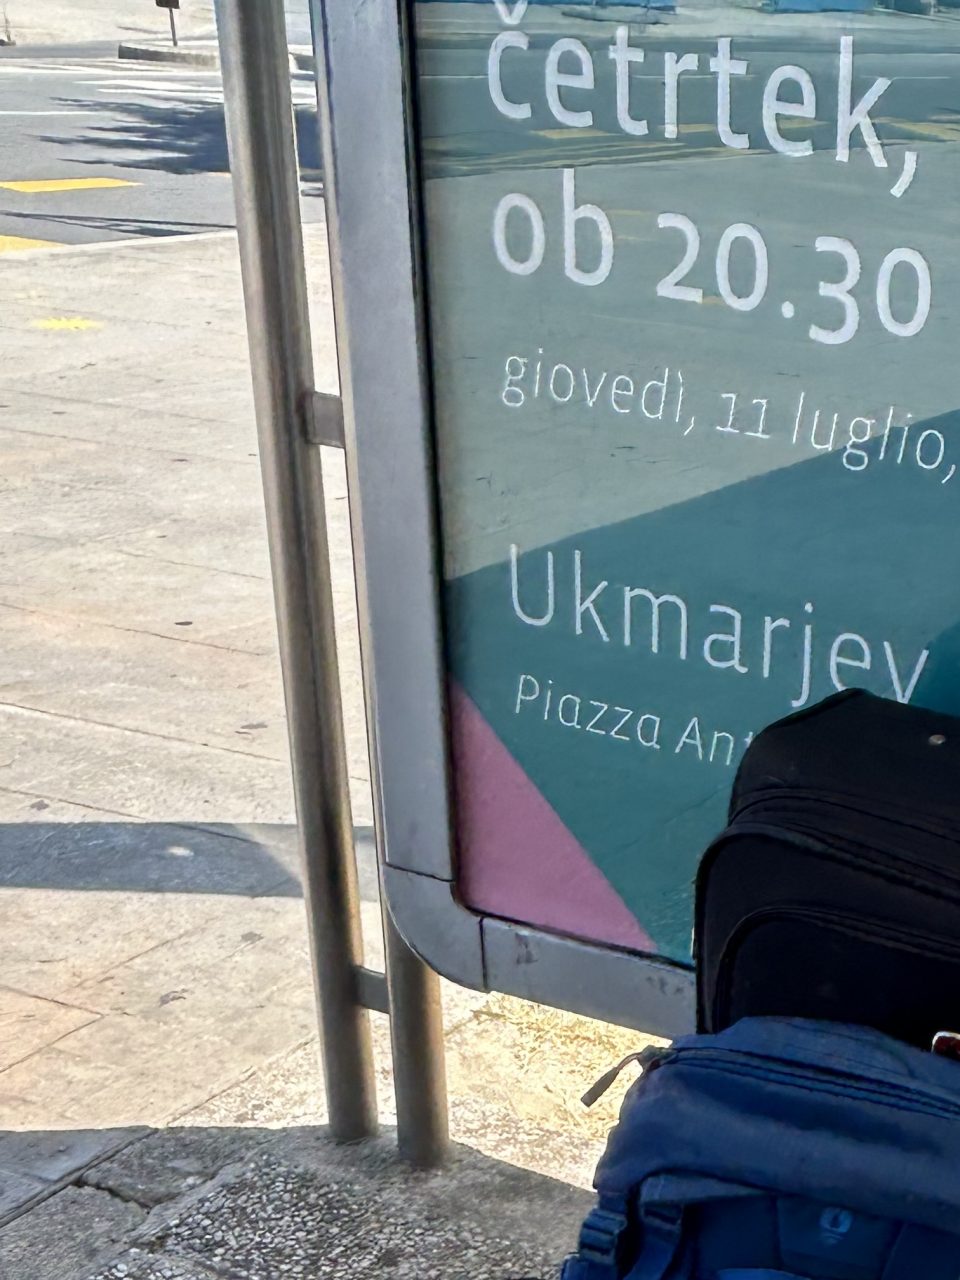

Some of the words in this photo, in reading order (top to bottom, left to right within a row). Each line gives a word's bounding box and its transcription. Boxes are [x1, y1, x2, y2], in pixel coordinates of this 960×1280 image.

[487, 0, 918, 198] četrtek,
[493, 167, 614, 287] ob
[655, 212, 933, 345] 20.30
[501, 347, 697, 437] giovedì,
[715, 392, 771, 439] 11
[791, 391, 957, 485] luglio,
[508, 543, 931, 708] Ukmarjev
[514, 674, 662, 751] Piazza
